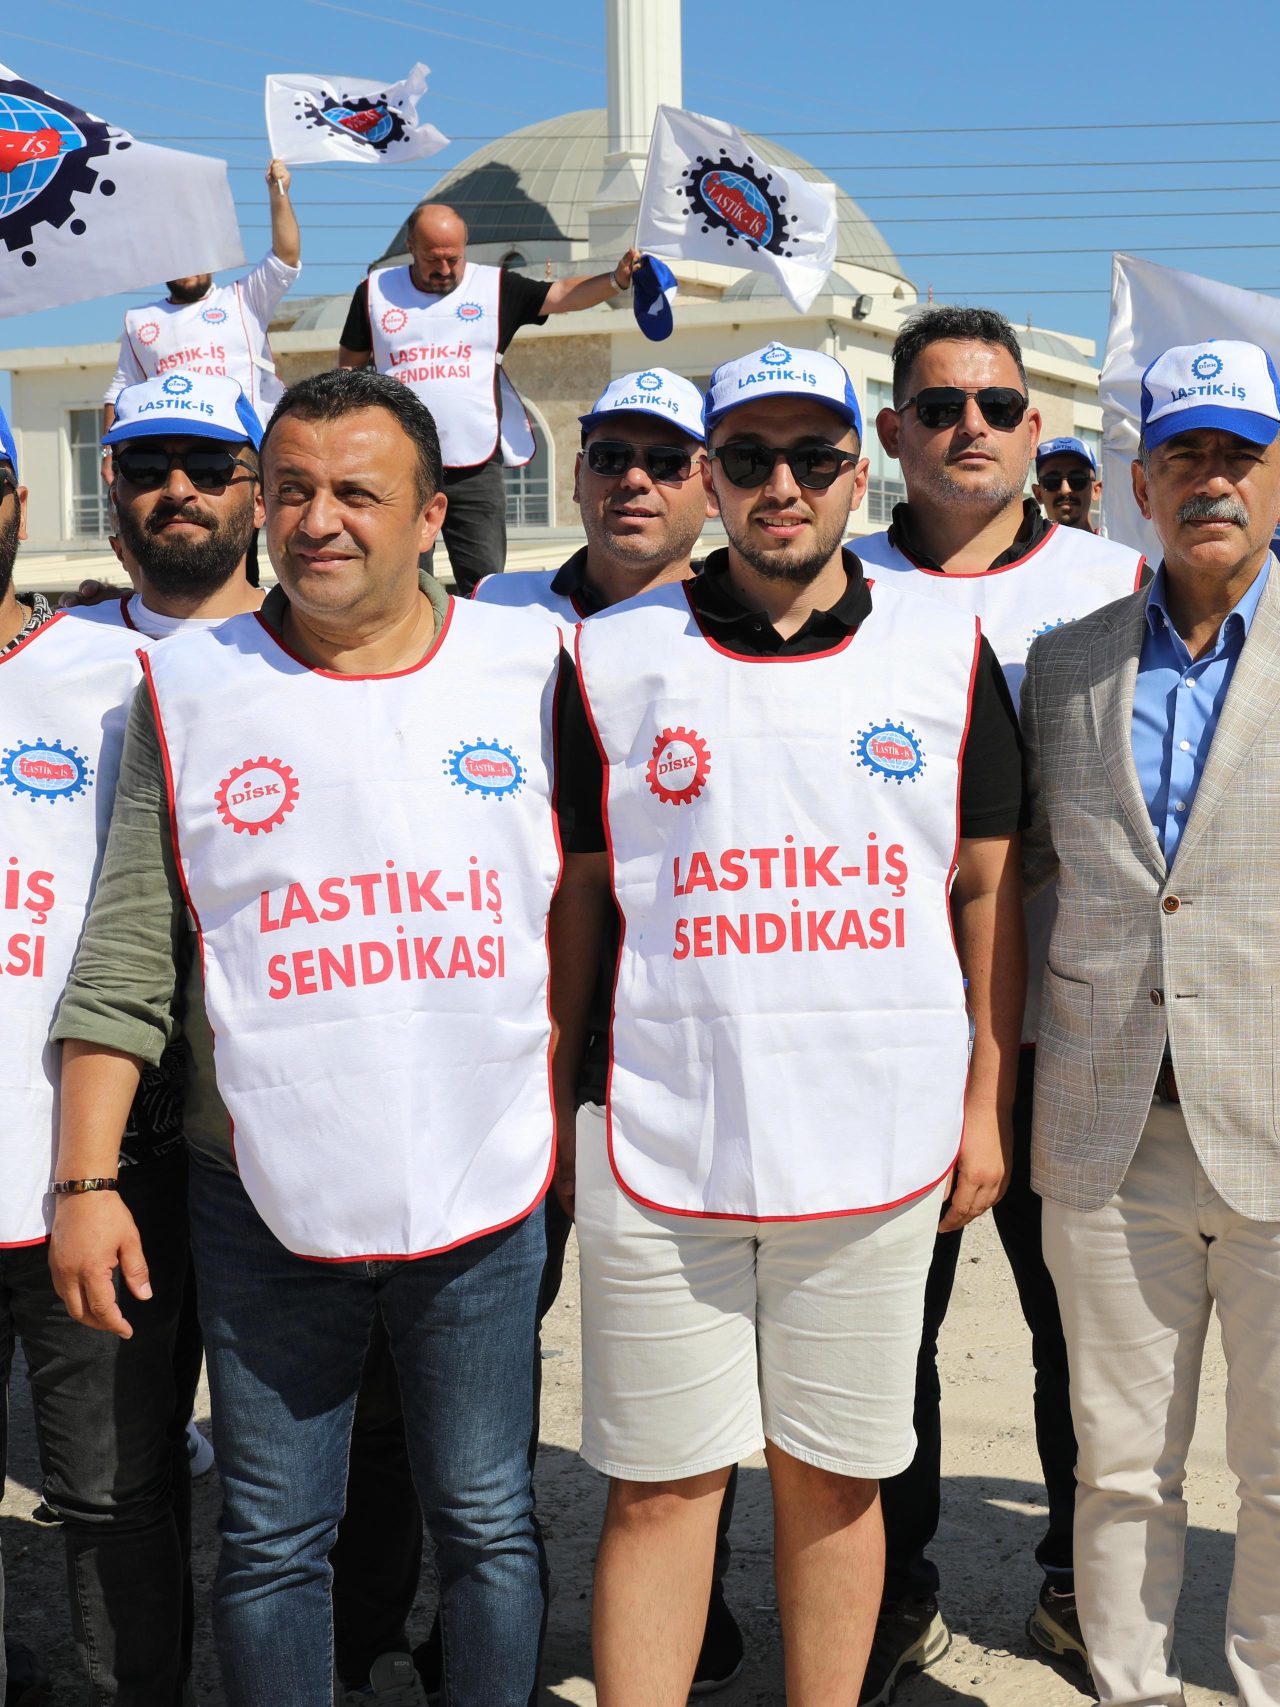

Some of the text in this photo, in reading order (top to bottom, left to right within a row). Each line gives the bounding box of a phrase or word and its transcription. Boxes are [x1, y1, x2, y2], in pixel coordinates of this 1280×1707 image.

[707, 186, 745, 221] LASTİK
[390, 341, 472, 366] LASTİK-İŞ
[738, 367, 817, 389] LASTİK-İŞ
[614, 392, 679, 414] LASTİK-İŞ
[1171, 382, 1246, 401] LASTİK-İŞ
[138, 397, 214, 416] LASTİK-İŞ
[658, 752, 696, 775] DİSK
[231, 781, 281, 806] DİSK
[673, 832, 908, 897] LASTİK-İŞ
[260, 856, 503, 933] LASTİK-İŞ
[672, 898, 905, 961] SENDİKASI
[267, 925, 505, 1000] SENDİKASI
